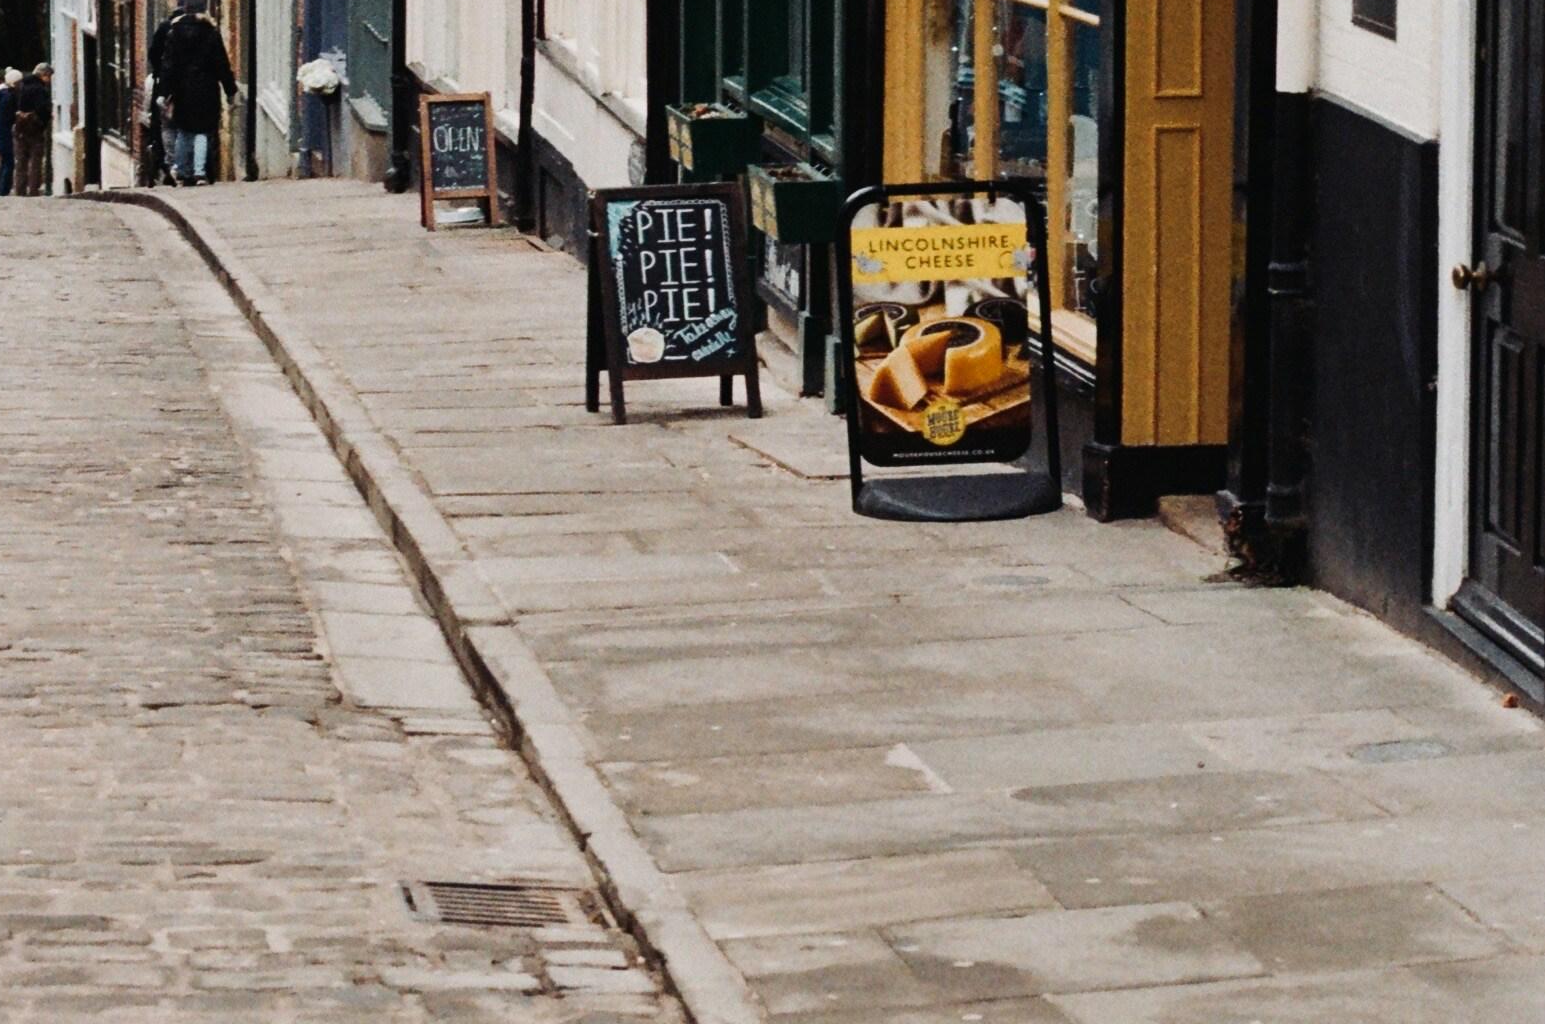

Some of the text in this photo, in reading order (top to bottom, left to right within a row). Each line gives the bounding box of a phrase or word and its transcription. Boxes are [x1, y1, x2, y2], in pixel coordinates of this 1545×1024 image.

[636, 207, 713, 245] PIE!
[869, 235, 1009, 254] LINCOLNSHIRE
[904, 254, 975, 270] CHEESE
[640, 247, 715, 285] PIE!
[644, 287, 716, 323] PIE!
